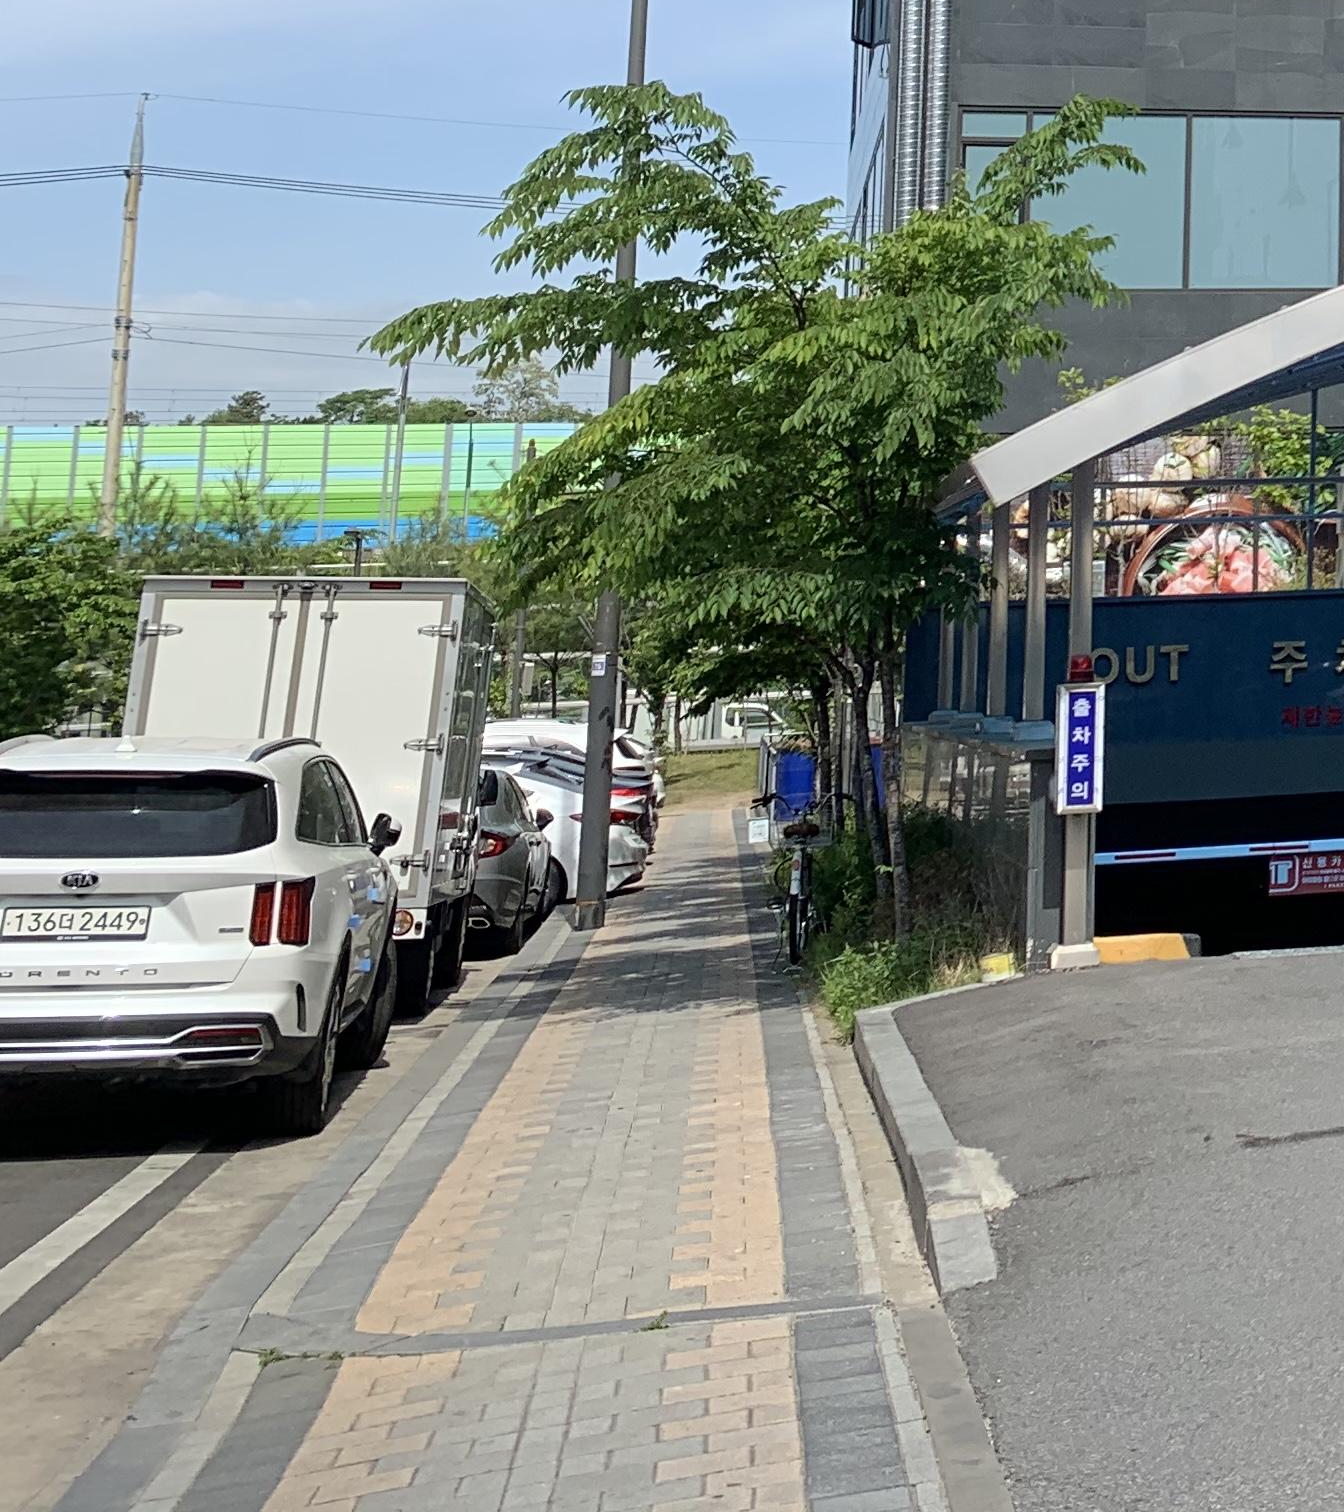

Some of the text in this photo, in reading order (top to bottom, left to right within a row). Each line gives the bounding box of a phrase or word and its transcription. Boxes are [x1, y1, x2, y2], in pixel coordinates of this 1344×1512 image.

[1092, 644, 1190, 685] OUT
[1070, 697, 1092, 800] 출차주의
[15, 911, 140, 932] 136더 2449
